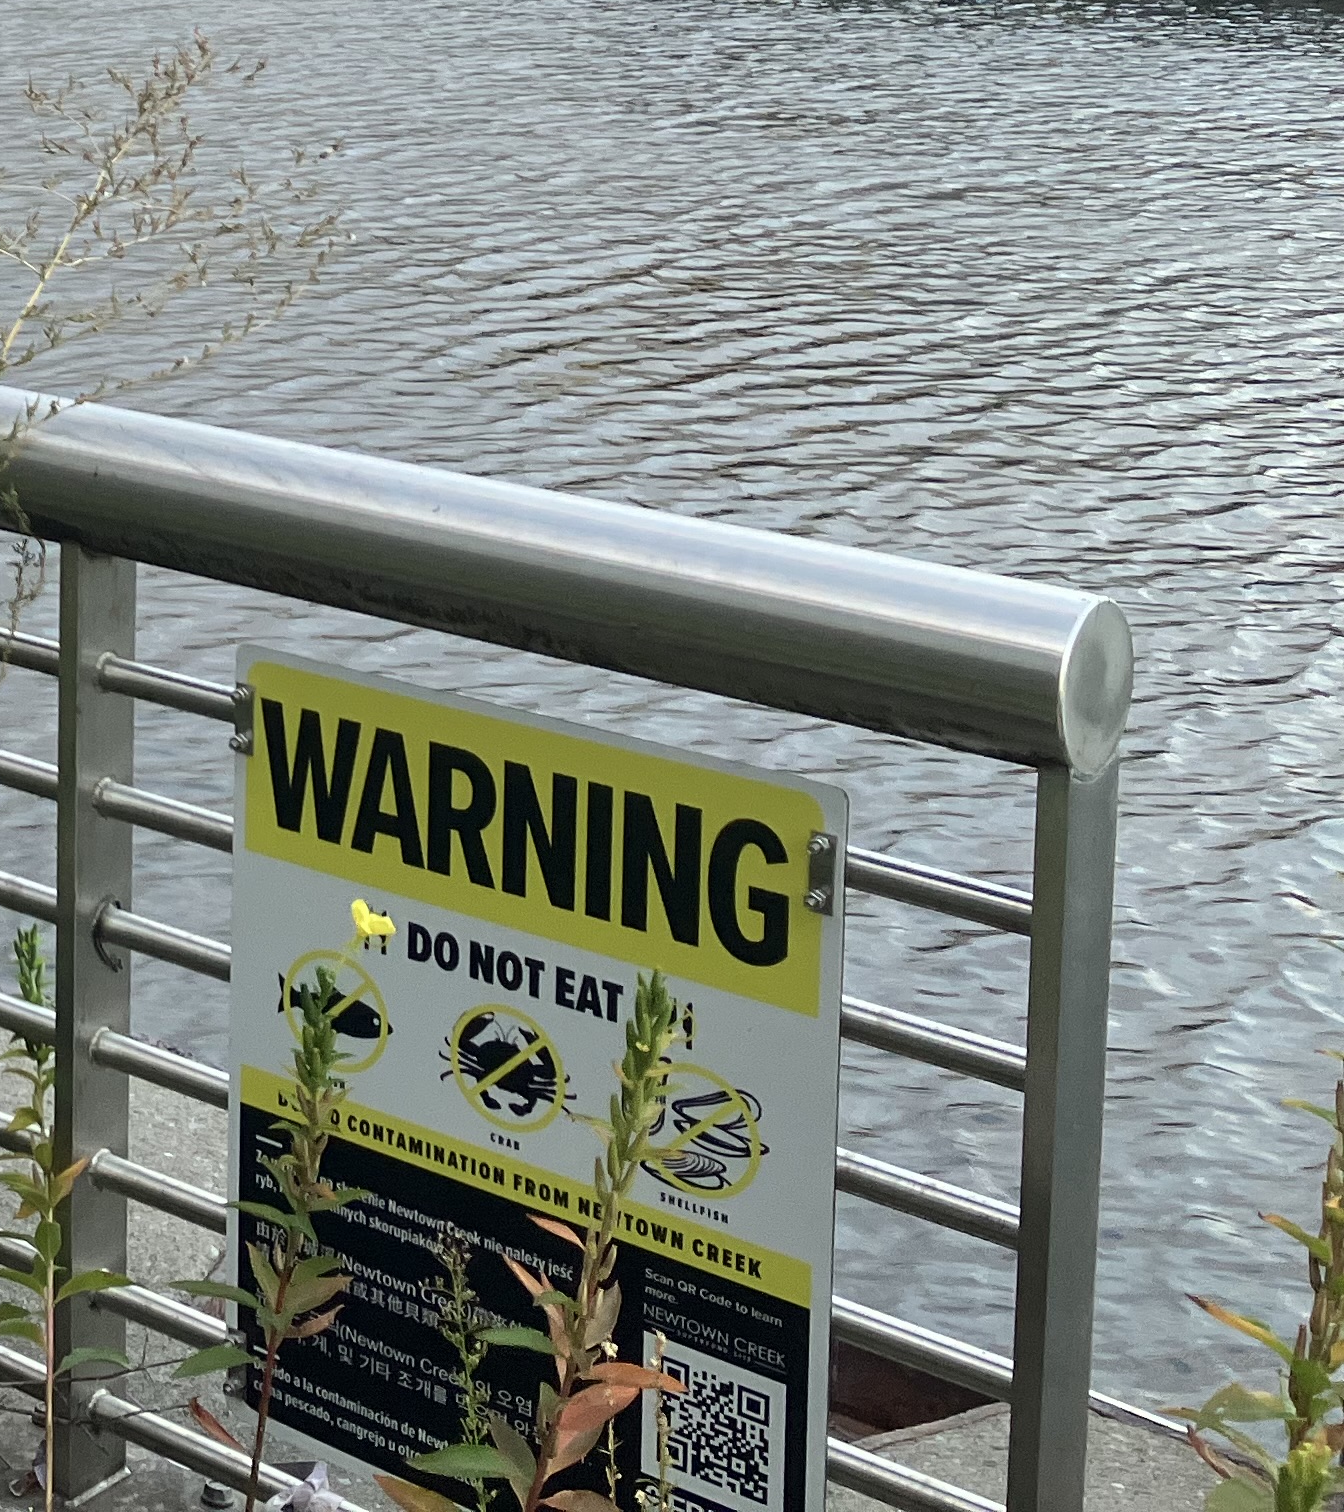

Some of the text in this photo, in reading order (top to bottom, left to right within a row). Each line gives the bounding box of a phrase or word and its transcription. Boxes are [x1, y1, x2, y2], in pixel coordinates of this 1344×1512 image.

[260, 697, 789, 967] WARNING
[407, 921, 624, 1023] DO NOT EAT
[347, 1114, 505, 1186] CONTAMINATION
[513, 1173, 569, 1209] FROM
[692, 1238, 762, 1280] CREEK
[388, 1198, 444, 1232] Newtown
[484, 1237, 503, 1254] nie
[660, 1191, 730, 1225] SHELLFISH
[644, 1286, 679, 1305] more.
[645, 1267, 783, 1328] Scan QR Code to learn
[643, 1302, 786, 1369] NEWTOWN CREEK
[284, 1393, 335, 1427] pescado,
[336, 1416, 386, 1448] cangrejo
[388, 1440, 396, 1452] u
[293, 1375, 301, 1389] a
[302, 1377, 314, 1395] la
[315, 1385, 399, 1432] contaminación
[400, 1422, 416, 1440] de
